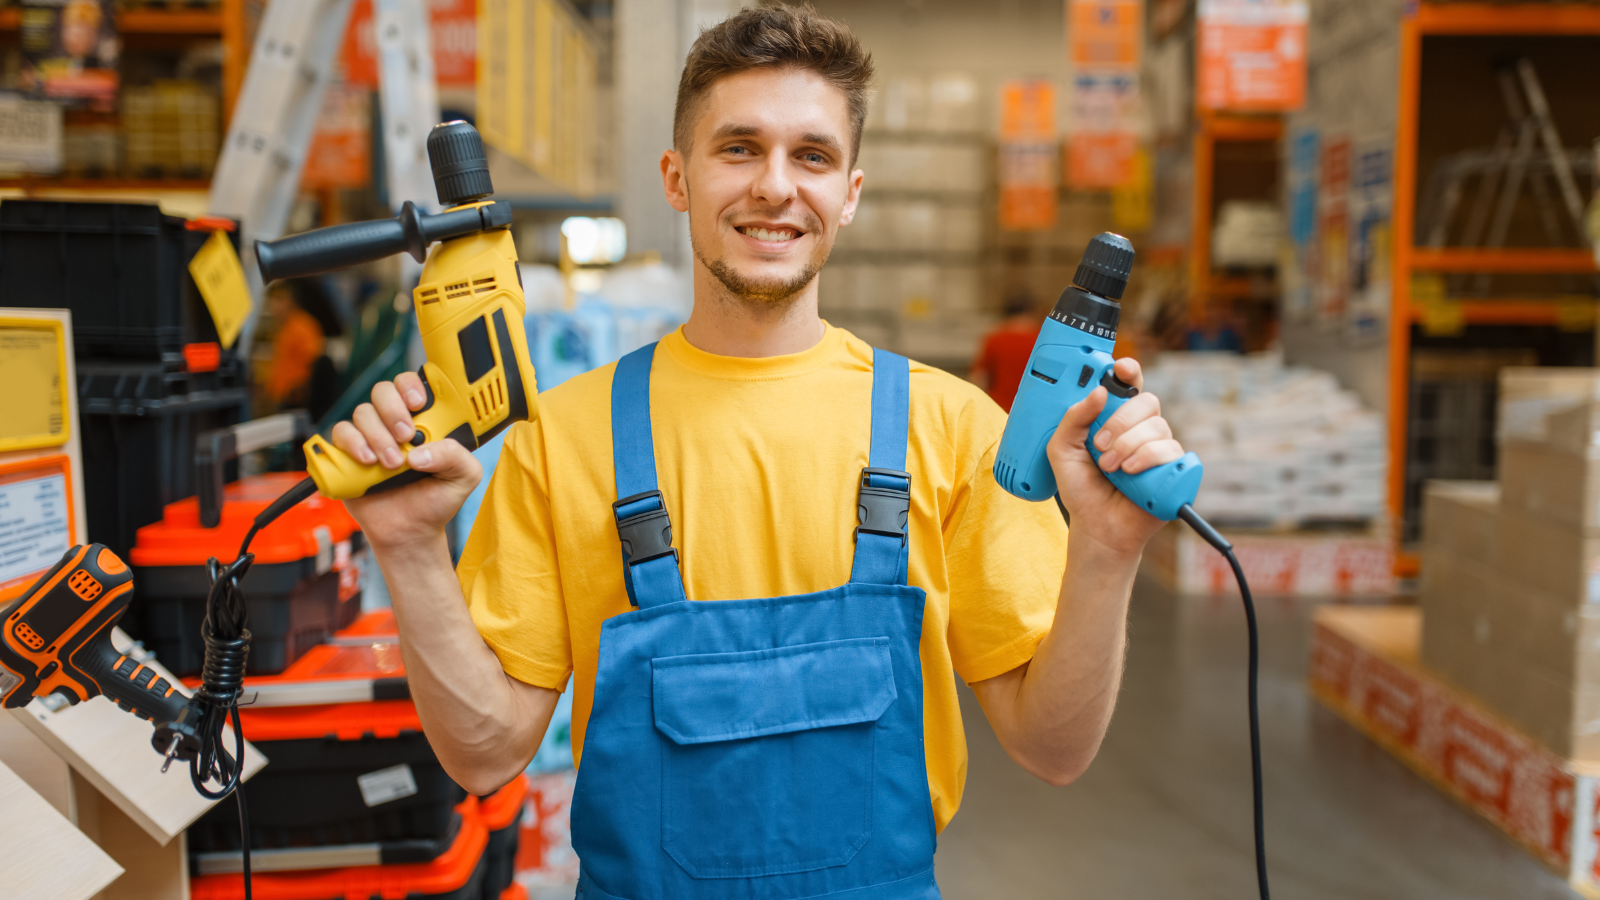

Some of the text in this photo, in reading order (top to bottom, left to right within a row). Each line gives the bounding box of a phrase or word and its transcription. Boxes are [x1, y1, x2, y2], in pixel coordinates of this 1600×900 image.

[1056, 312, 1061, 320] 5
[1070, 318, 1076, 326] 7
[1080, 321, 1086, 330] 8
[1089, 324, 1094, 333] 9
[1097, 327, 1104, 336] 10
[1104, 329, 1110, 337] 11
